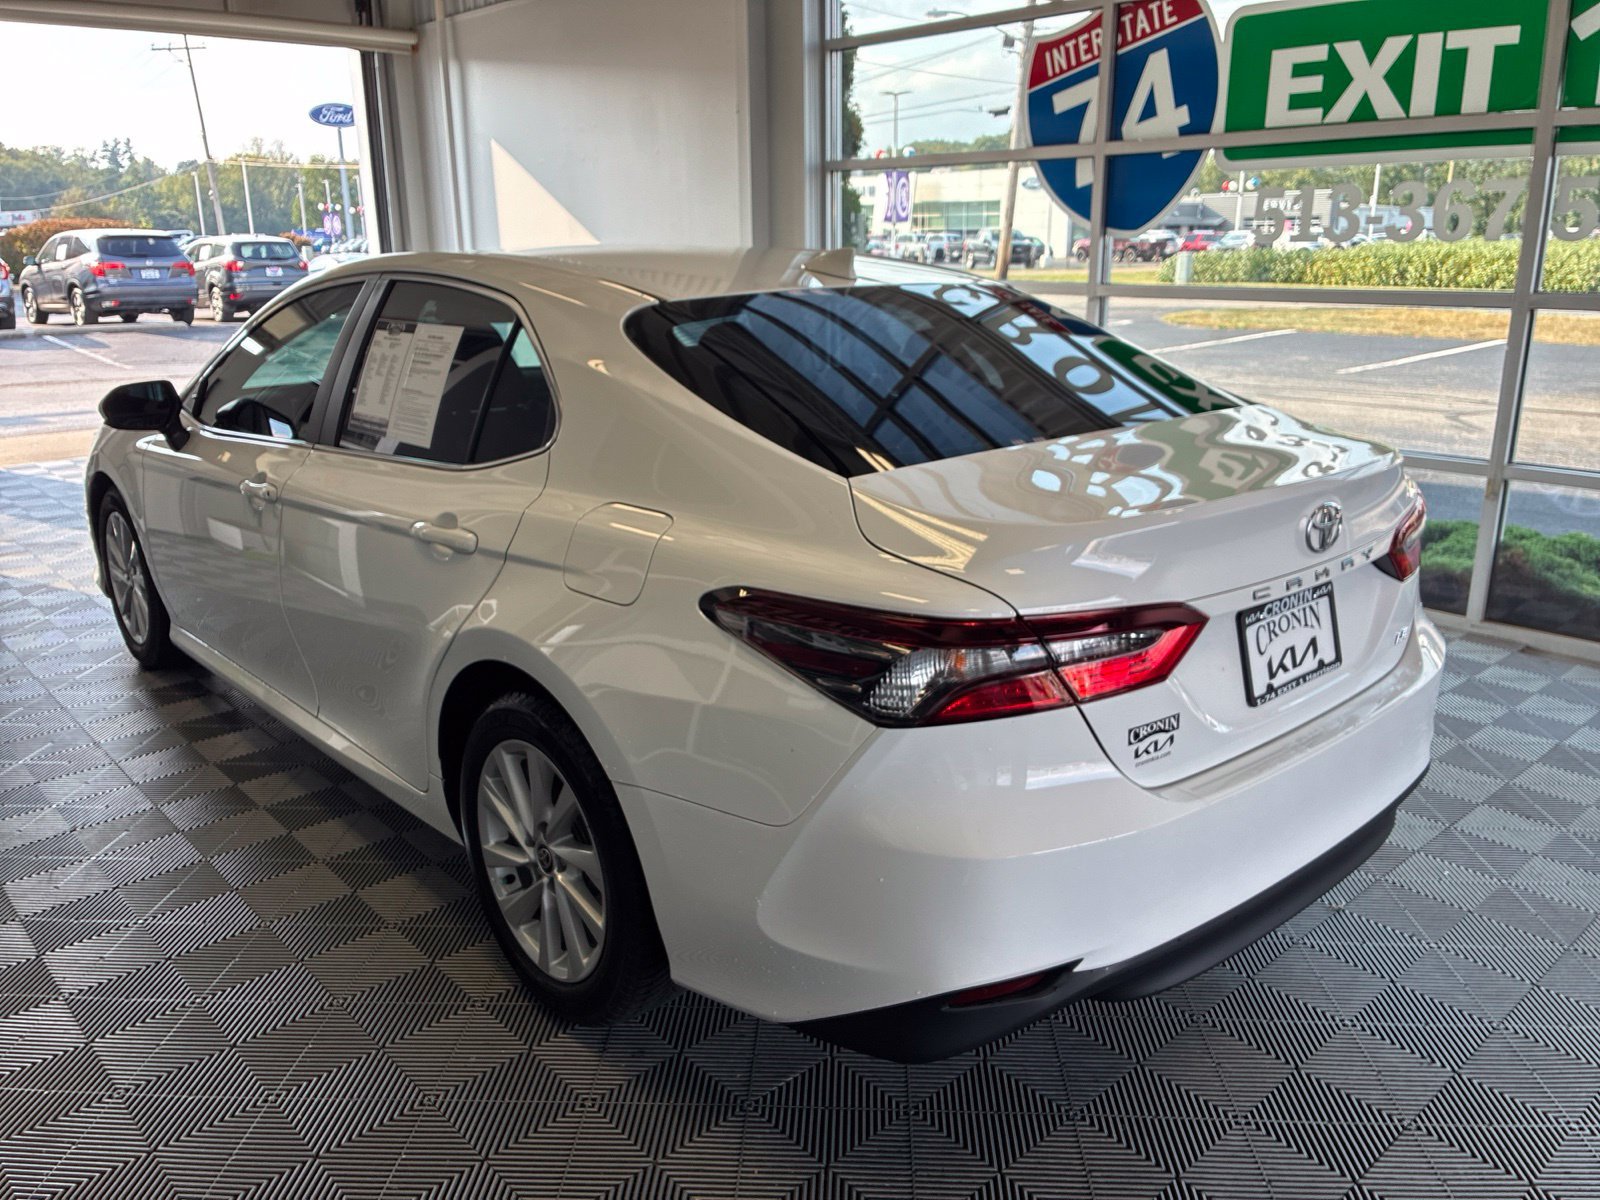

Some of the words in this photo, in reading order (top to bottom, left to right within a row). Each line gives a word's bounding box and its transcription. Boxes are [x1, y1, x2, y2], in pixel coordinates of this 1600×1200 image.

[1045, 0, 1178, 78] INTERTATE
[1265, 25, 1521, 128] EXIT
[319, 106, 352, 124] Ford
[1052, 47, 1191, 189] 74
[1252, 546, 1374, 601] CAMRY
[1256, 602, 1321, 655] CRONIN
[1263, 587, 1314, 619] CRONIN
[1267, 635, 1318, 680] KIA
[1130, 714, 1178, 744] CRONIN
